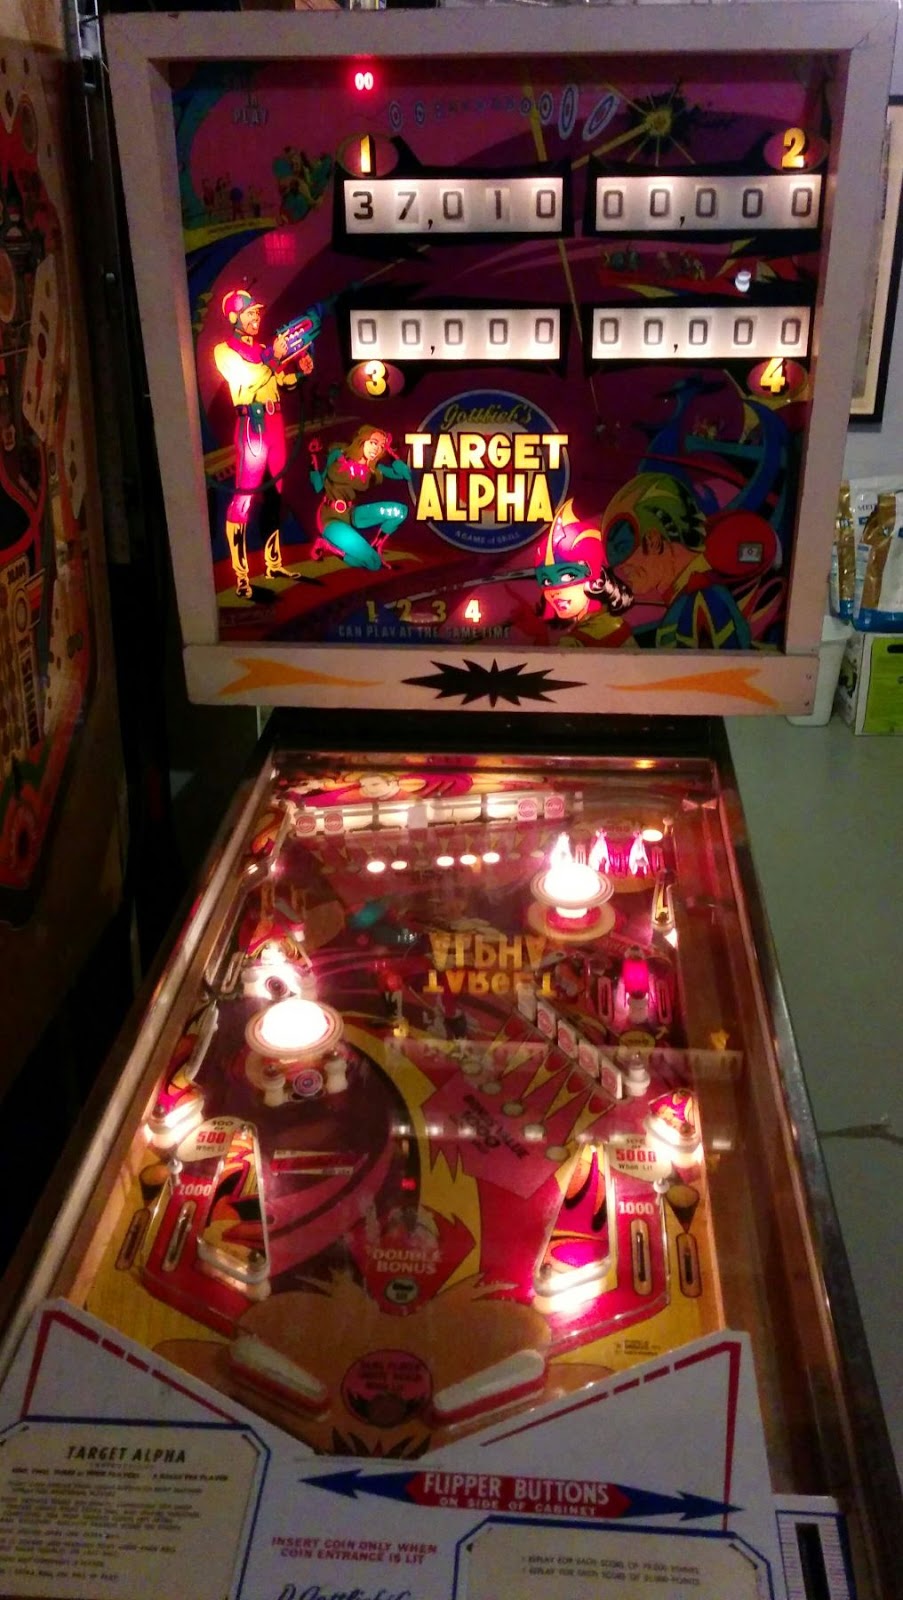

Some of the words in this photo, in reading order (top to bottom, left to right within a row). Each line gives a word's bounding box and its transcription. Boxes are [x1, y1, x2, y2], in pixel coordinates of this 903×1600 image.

[782, 128, 805, 168] 2
[365, 360, 387, 396] 3
[760, 357, 785, 392] 4
[404, 433, 568, 470] TARGET
[416, 473, 554, 522] ALPHA
[431, 600, 448, 622] 3
[464, 599, 482, 623] 4
[178, 1183, 213, 1197] 1000
[618, 1201, 655, 1215] 1000
[376, 1260, 437, 1275] BONUS
[66, 1446, 127, 1461] TARGET
[132, 1448, 187, 1464] ALPHA
[423, 1472, 501, 1499] FLIPPER
[514, 1478, 610, 1506] BUTTONS
[439, 1496, 459, 1507] ON
[468, 1497, 498, 1510] SIDE
[508, 1500, 527, 1511] OF
[534, 1502, 597, 1516] CABINET
[271, 1536, 320, 1549] INSERT
[323, 1539, 355, 1550] COIN
[358, 1540, 392, 1552] ONLY
[397, 1543, 438, 1553] WHEN
[280, 1547, 313, 1558] COIN
[317, 1550, 384, 1562] ENTRANCE
[405, 1554, 425, 1564] LIT
